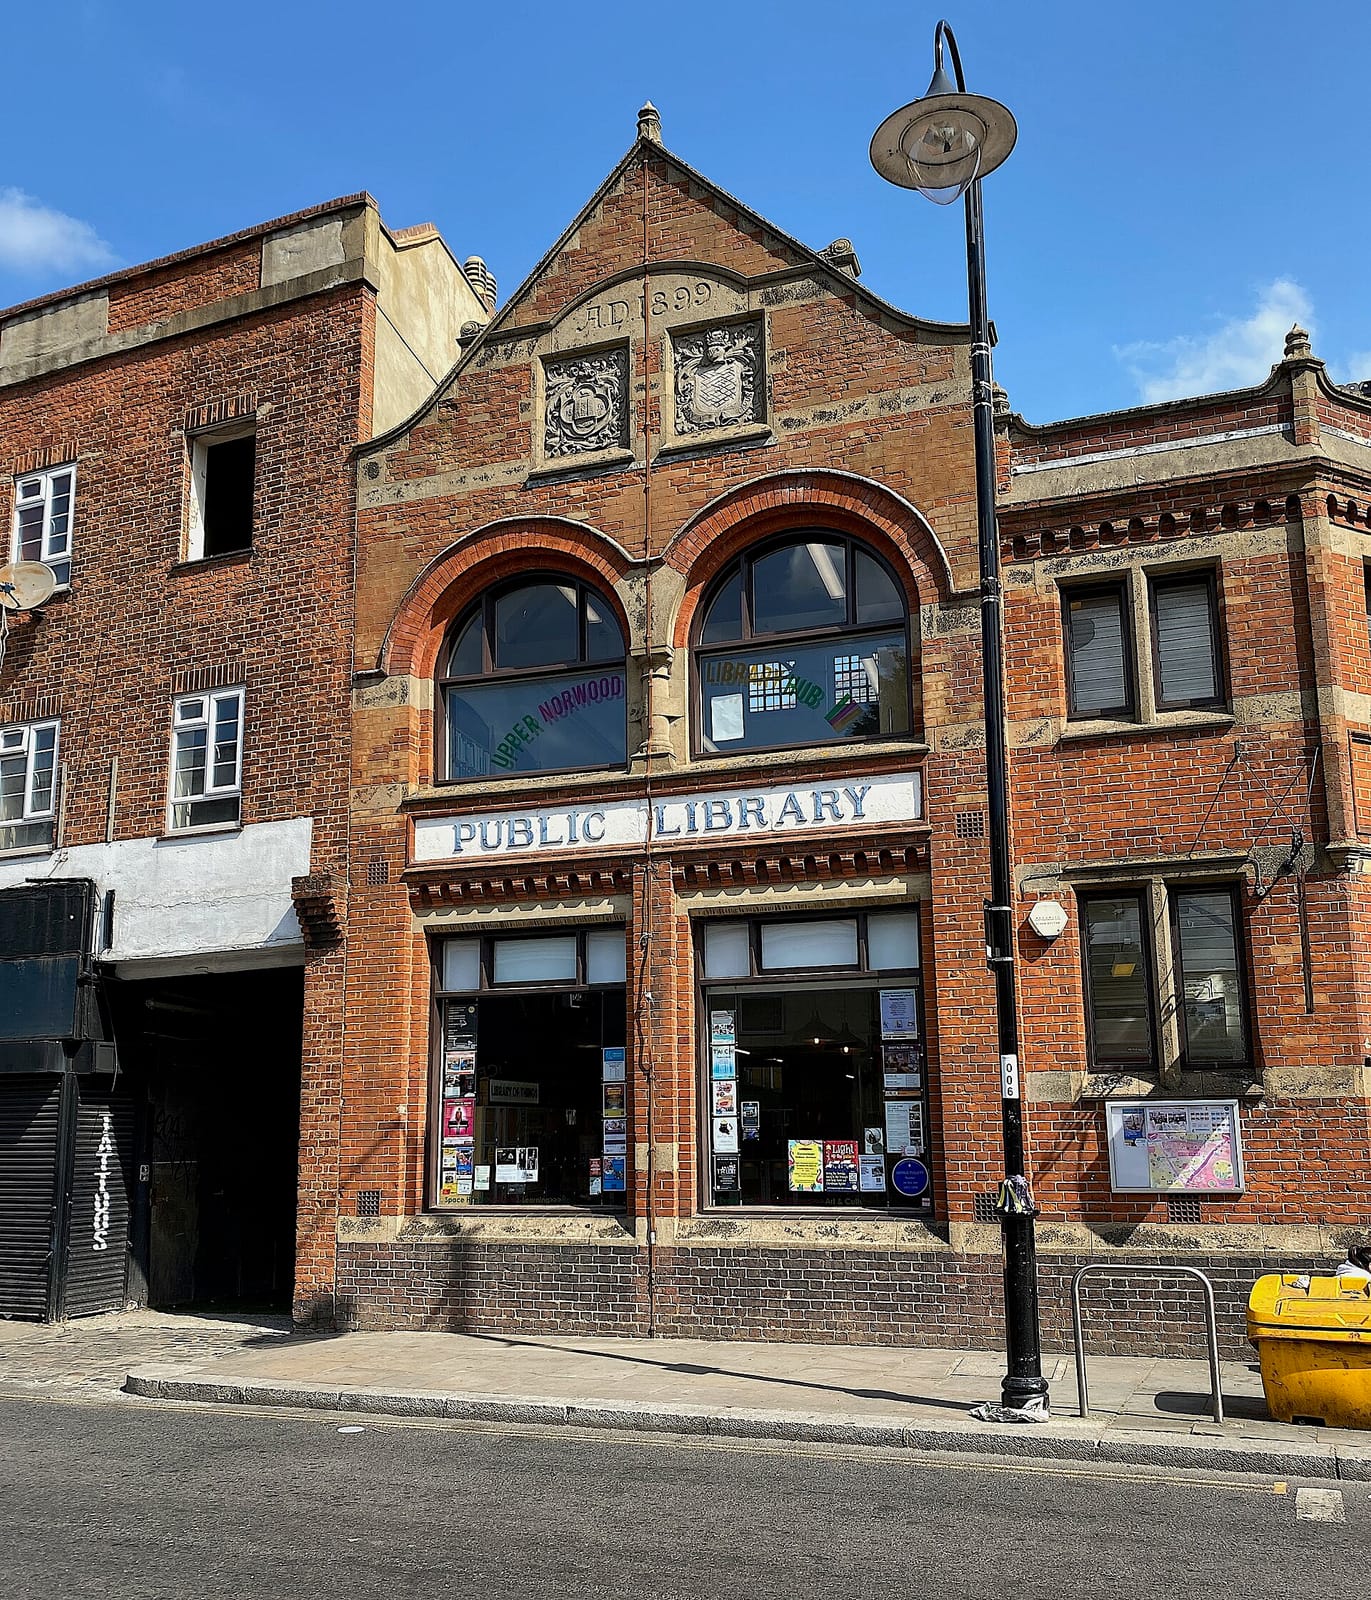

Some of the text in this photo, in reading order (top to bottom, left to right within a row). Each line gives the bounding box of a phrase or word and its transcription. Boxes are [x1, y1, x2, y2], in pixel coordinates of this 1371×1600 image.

[638, 282, 712, 319] 1899
[491, 675, 622, 769] UPPER NORWOOD
[450, 785, 872, 854] PUBLIC LIBRARY
[444, 1196, 465, 1204] Space
